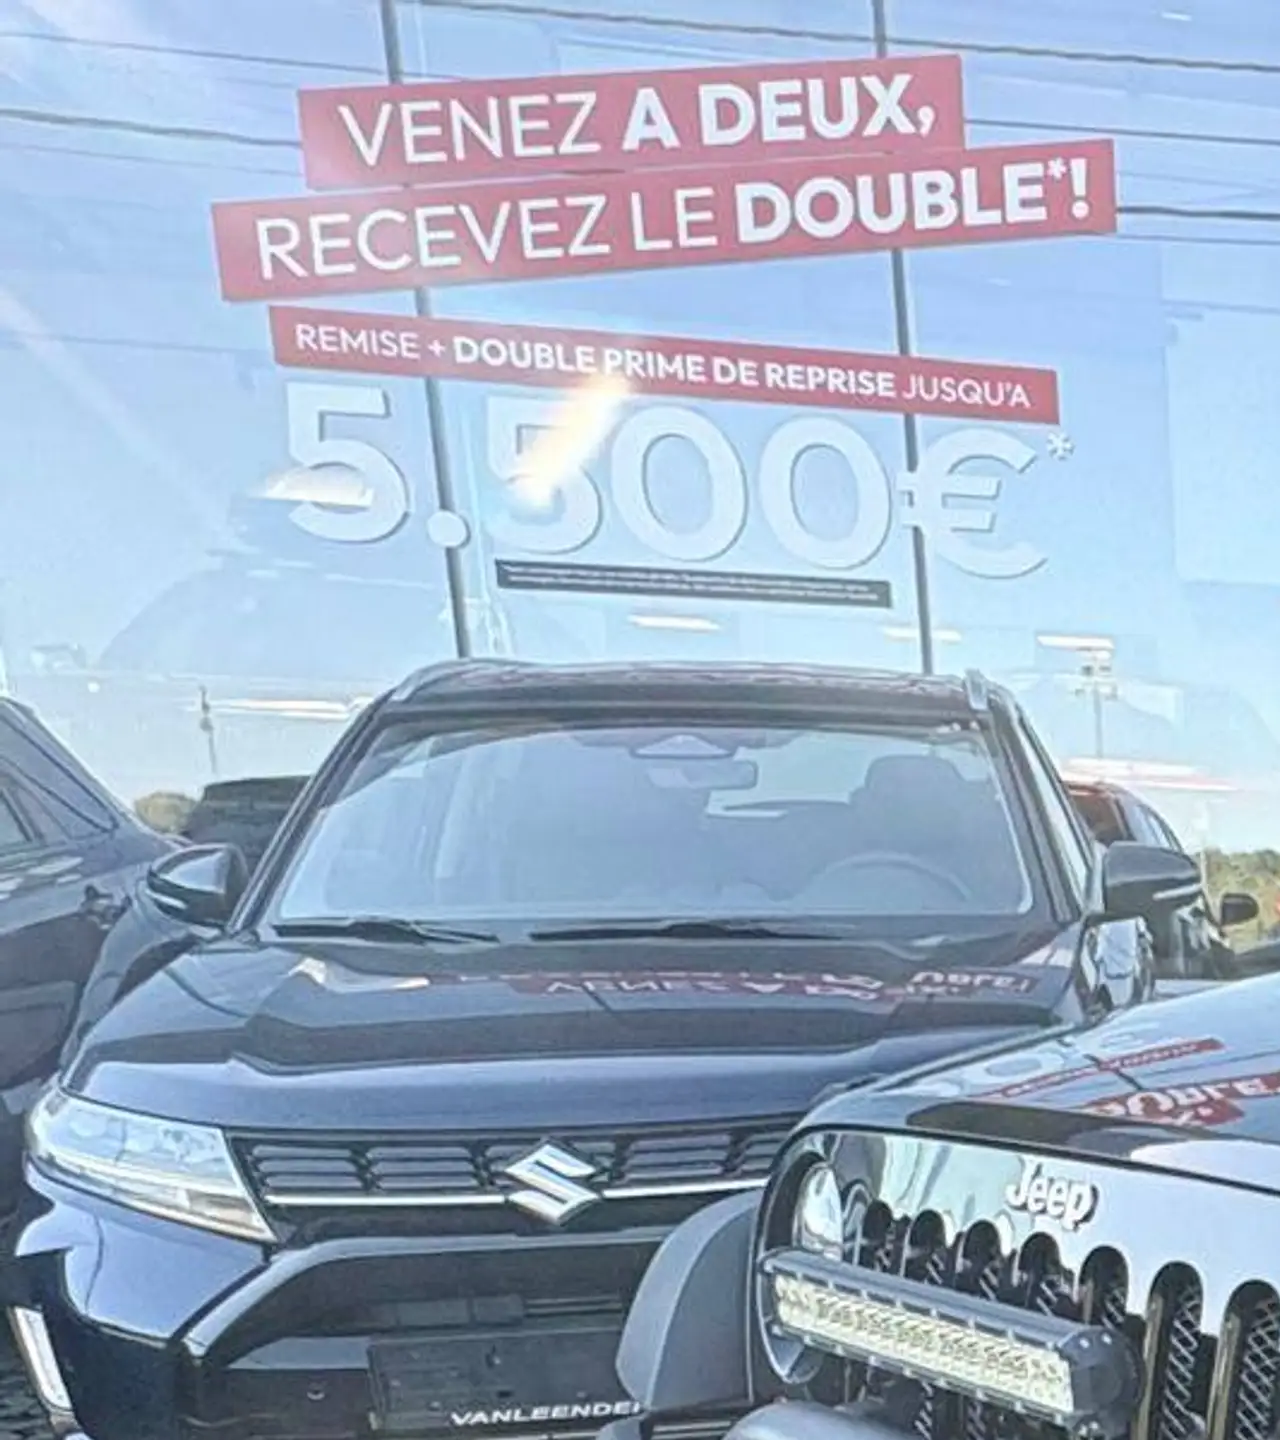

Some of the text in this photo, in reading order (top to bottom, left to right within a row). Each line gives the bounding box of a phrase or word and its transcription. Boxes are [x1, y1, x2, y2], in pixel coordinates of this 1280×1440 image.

[337, 73, 936, 167] VENEZ A DEUX,
[257, 193, 612, 280] RECEVEZ
[630, 187, 718, 252] LE
[295, 323, 421, 359] REMISE
[452, 335, 596, 373] DOUBLE
[603, 347, 706, 383] PRIME
[712, 355, 759, 387] DE
[763, 362, 897, 398] REPRISE
[901, 374, 1031, 408] JUSQU'A
[1005, 1157, 1098, 1231] Jeep
